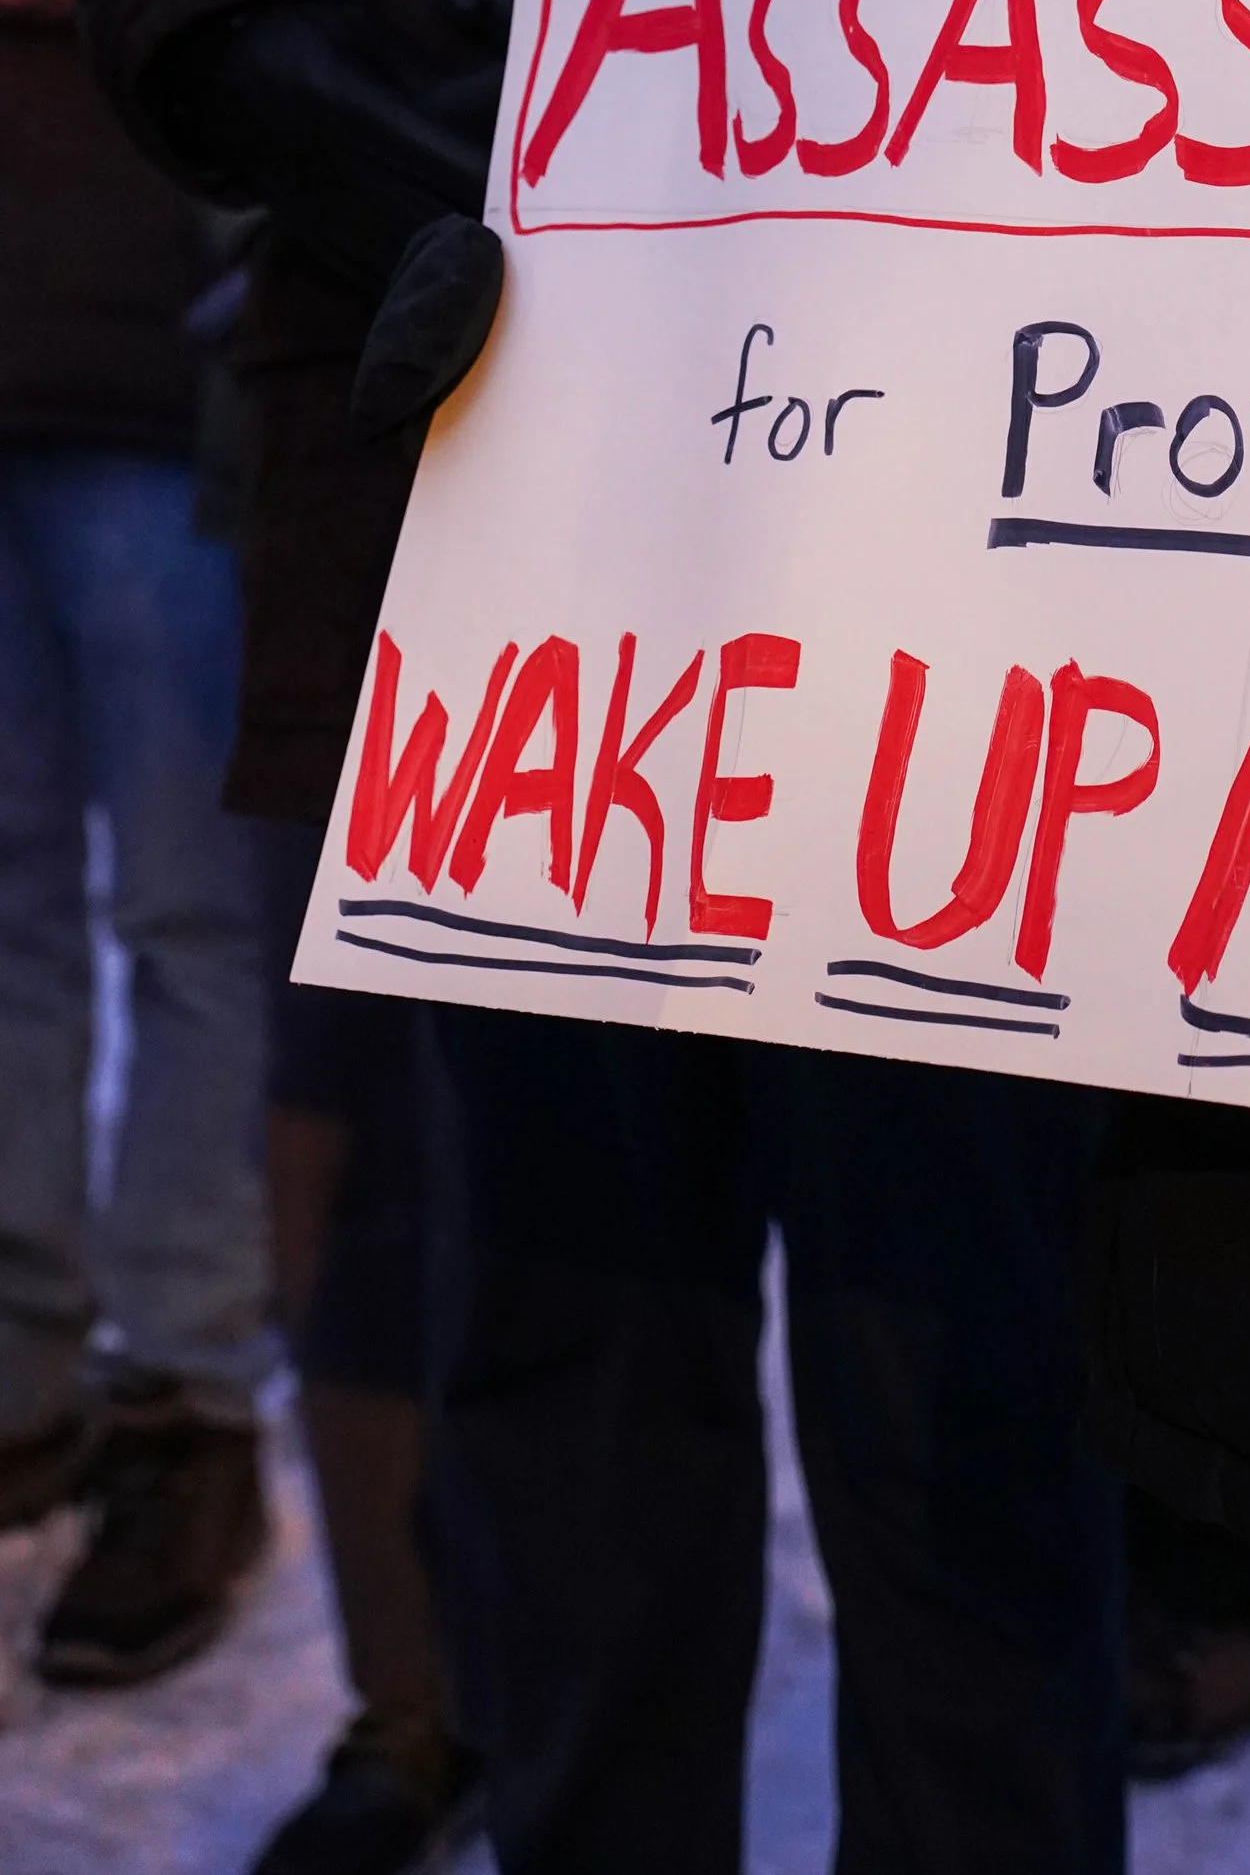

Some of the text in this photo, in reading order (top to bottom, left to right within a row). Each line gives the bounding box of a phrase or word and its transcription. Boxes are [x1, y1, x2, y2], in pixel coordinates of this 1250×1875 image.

[711, 322, 885, 465] for
[345, 627, 802, 945] WAKE
[854, 647, 1161, 984] UP
